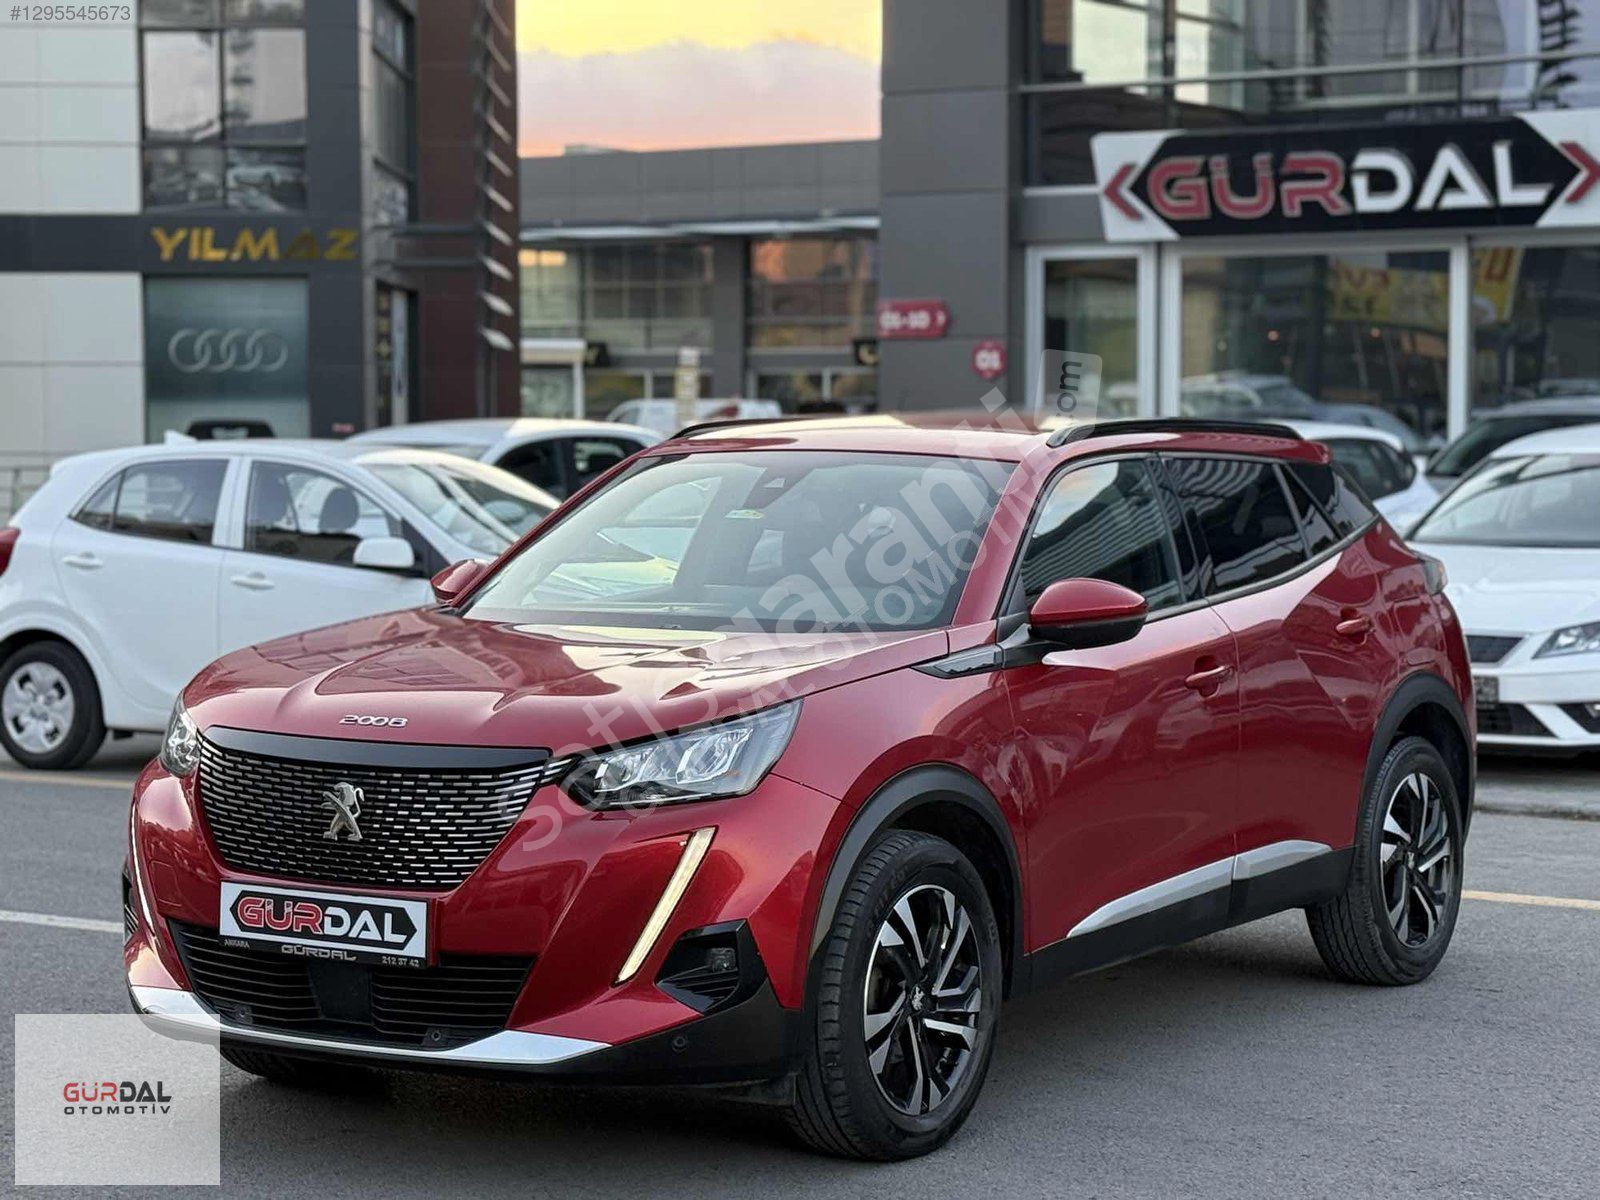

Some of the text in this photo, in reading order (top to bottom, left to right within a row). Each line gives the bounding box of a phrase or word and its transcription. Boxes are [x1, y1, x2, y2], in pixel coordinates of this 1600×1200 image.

[1147, 139, 1553, 220] GÜRDAL
[151, 226, 358, 262] YILMAZ
[339, 714, 408, 727] 2008
[237, 897, 407, 944] GÜRDAL
